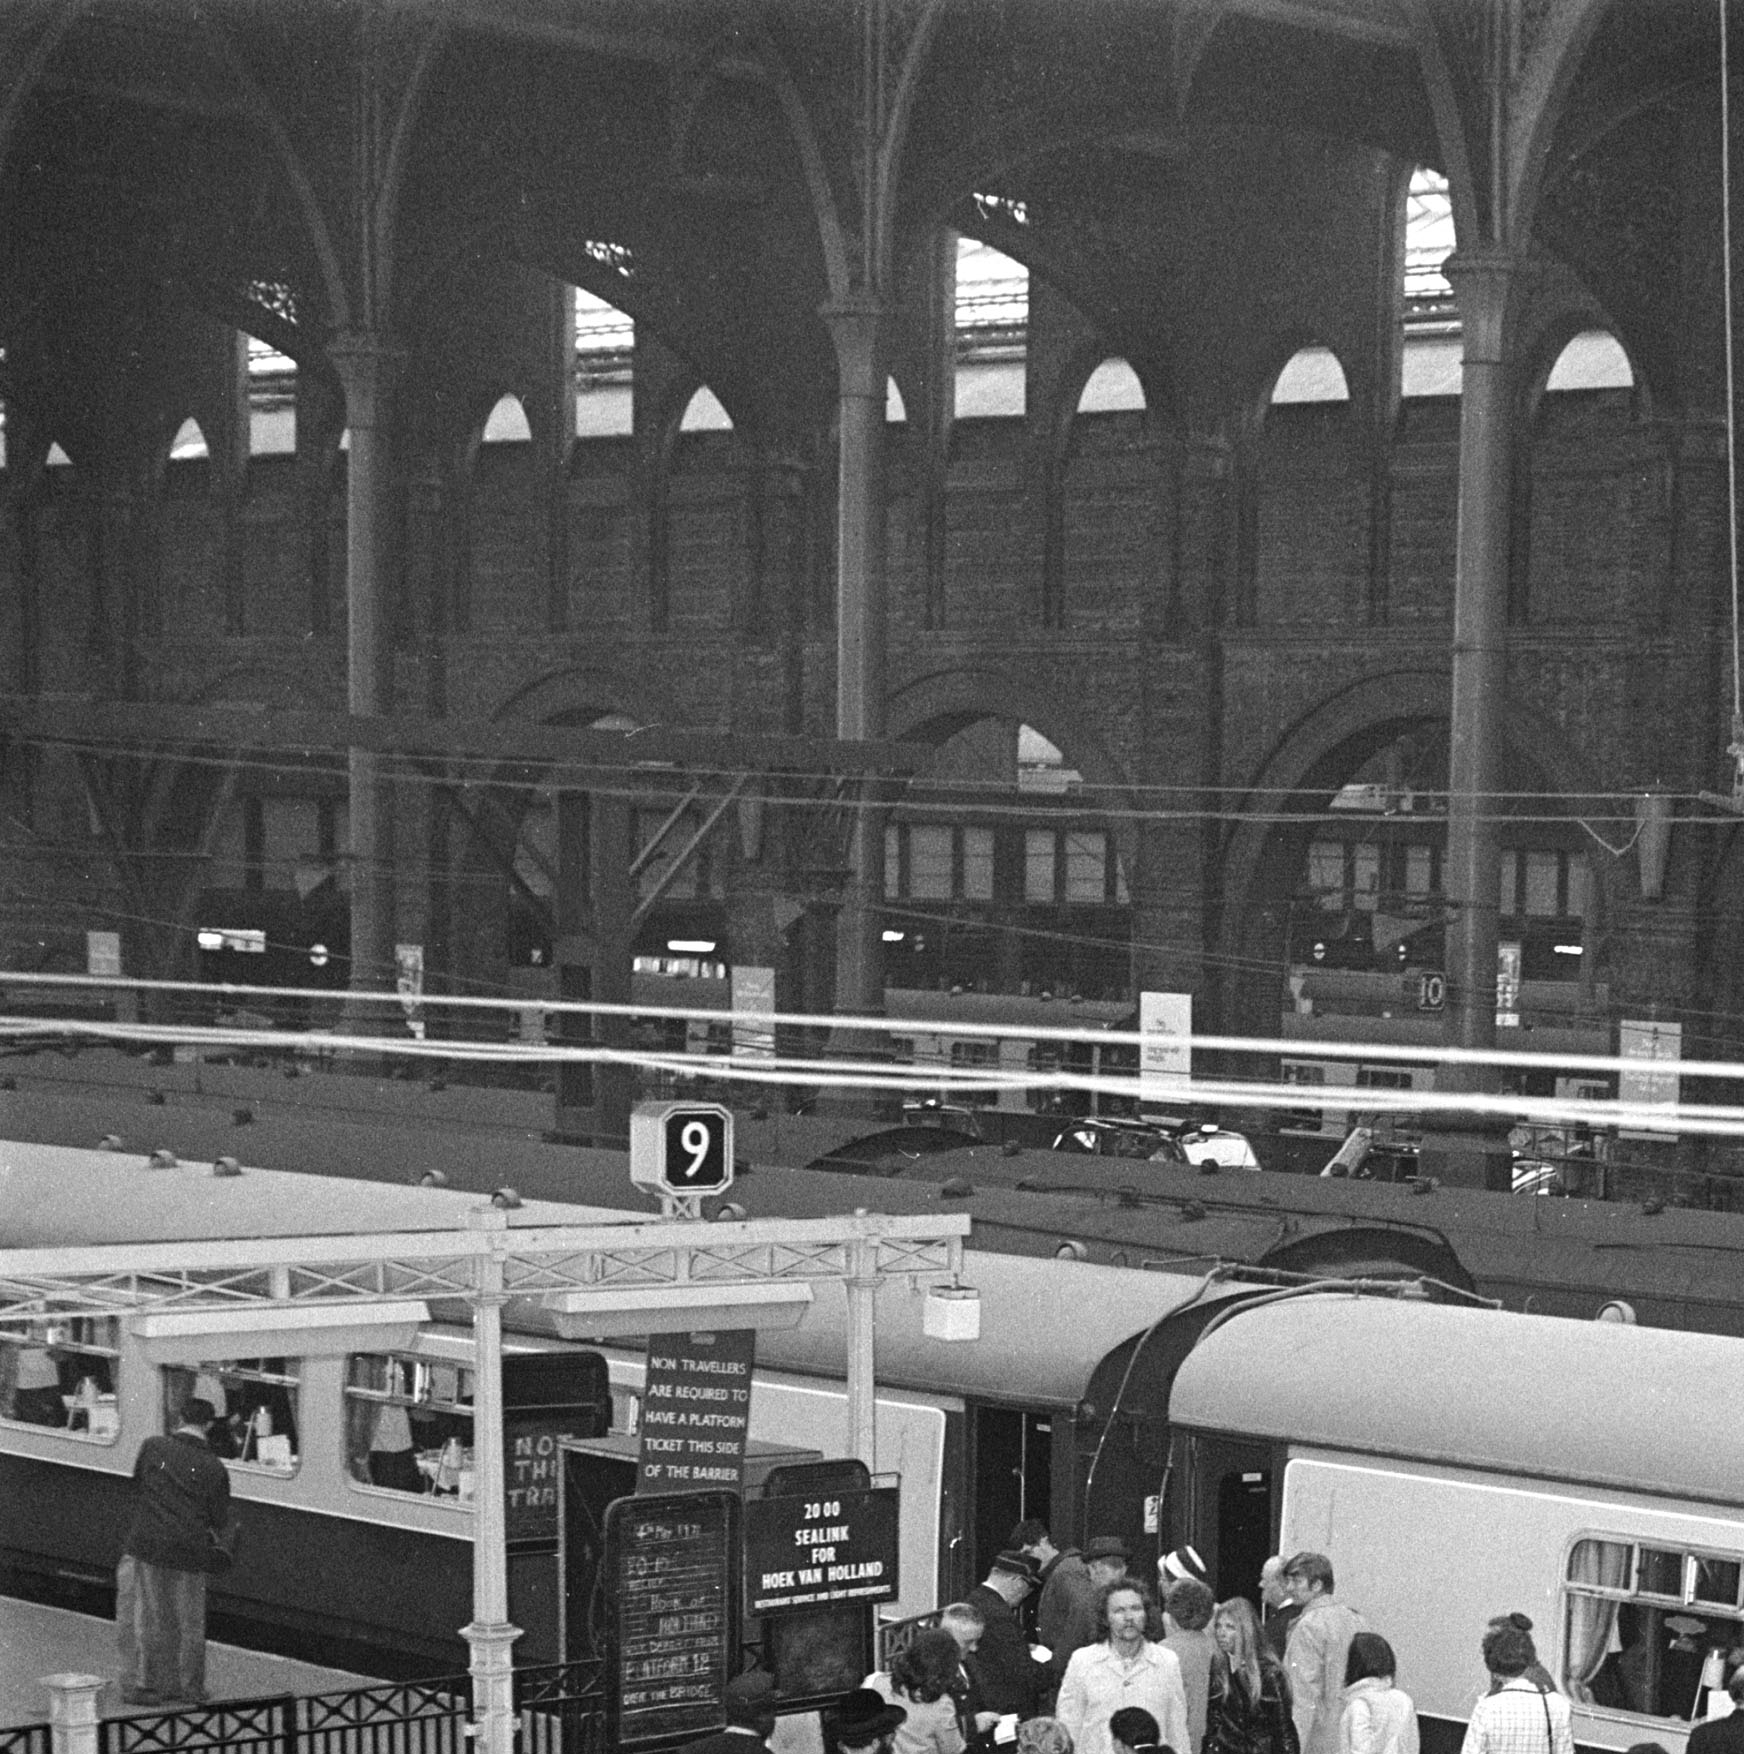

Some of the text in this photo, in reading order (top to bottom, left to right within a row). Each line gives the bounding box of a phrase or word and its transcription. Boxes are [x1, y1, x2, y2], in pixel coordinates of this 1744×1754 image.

[1421, 977, 1442, 1005] 10
[681, 1121, 710, 1178] 9
[651, 1357, 746, 1375] NON TRAVELLERS
[648, 1384, 747, 1401] ARE REQUIRED TO
[645, 1411, 745, 1428] HAVE A PLATFORM
[644, 1438, 739, 1454] TICKET THIS SIDE
[514, 1459, 556, 1480] THI
[645, 1465, 739, 1481] OF THE BARRIER
[795, 1525, 849, 1546] SEALINK
[811, 1546, 836, 1564] FOR
[762, 1561, 883, 1590] HOEK VAN HOLLAND
